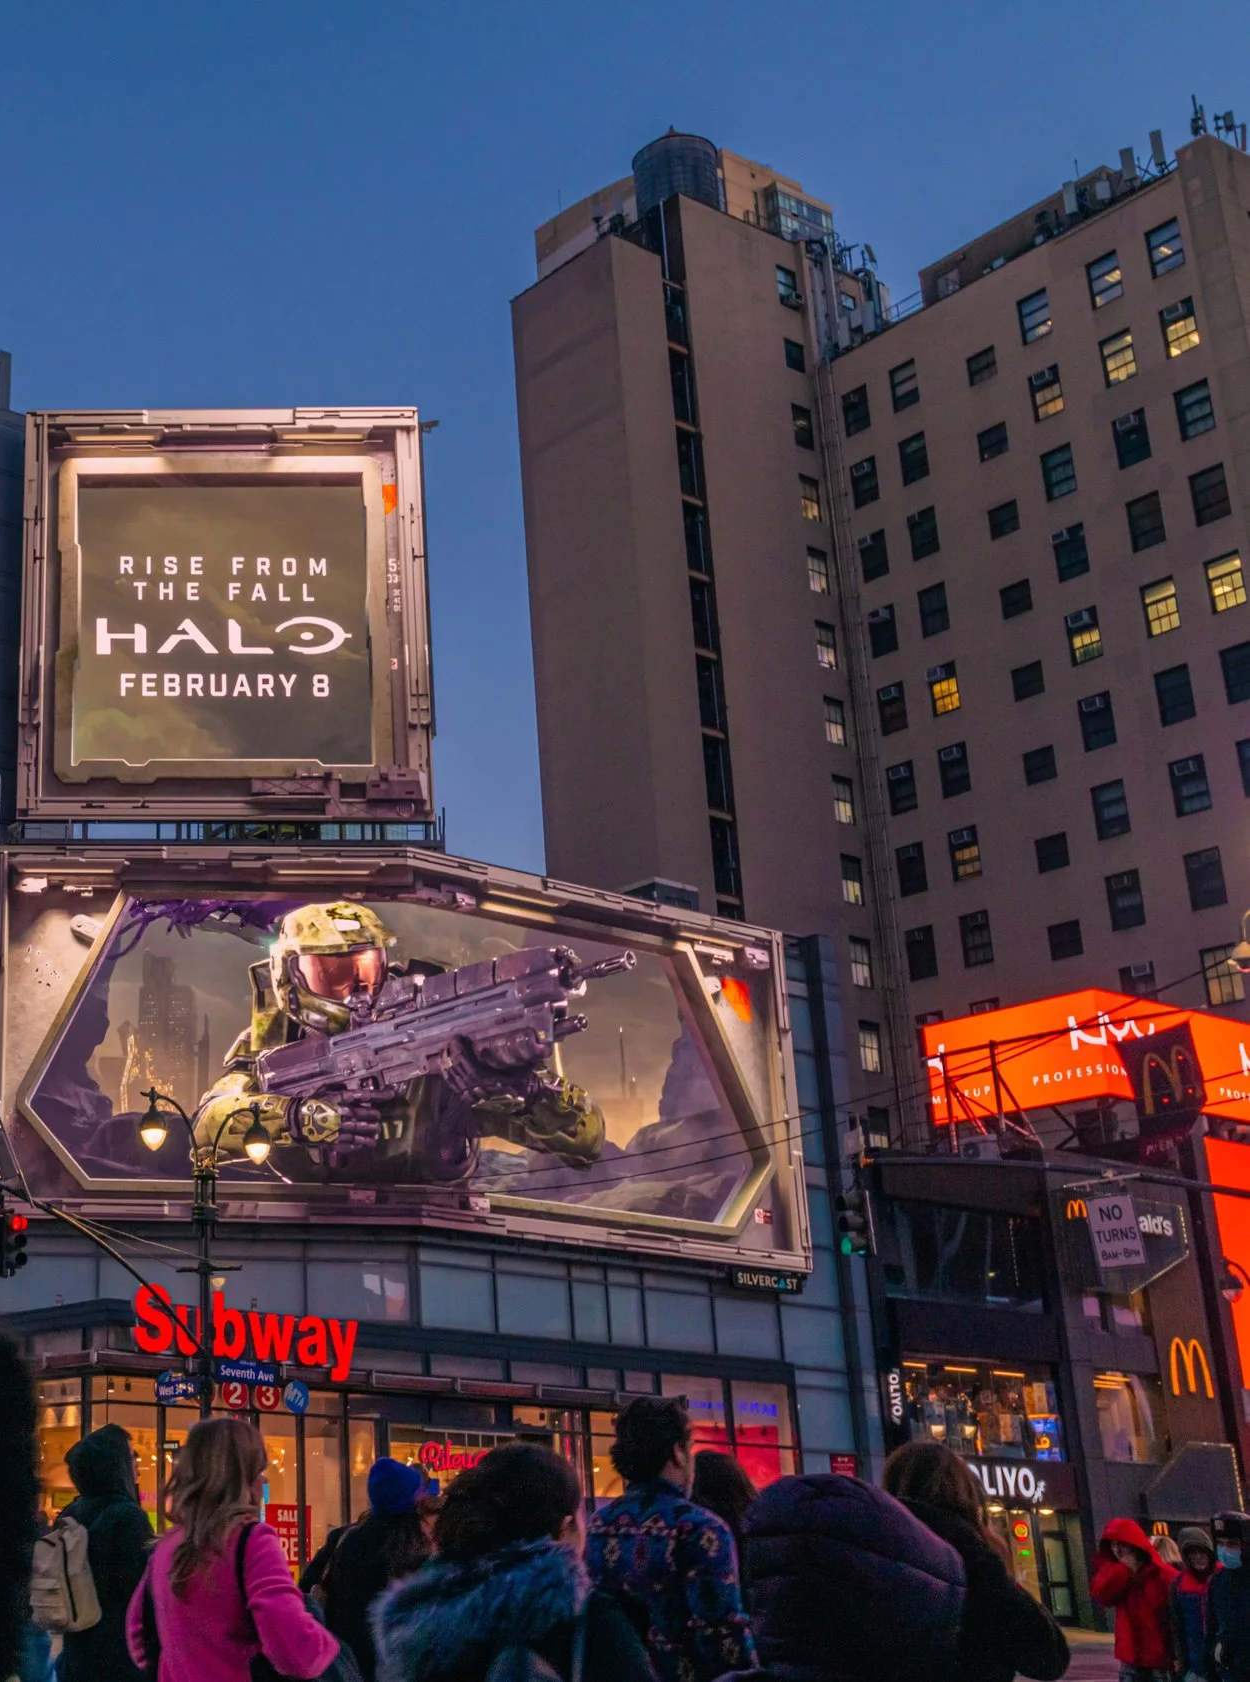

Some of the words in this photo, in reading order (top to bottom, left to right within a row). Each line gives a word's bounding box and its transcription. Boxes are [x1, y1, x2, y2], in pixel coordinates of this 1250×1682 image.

[120, 556, 203, 575] RISE
[232, 557, 327, 576] FROM
[134, 582, 200, 600] THE
[228, 583, 315, 601] FALL
[96, 616, 352, 655] HALO
[120, 673, 297, 697] FEBRUARY
[313, 674, 329, 697] 8
[932, 1085, 991, 1105] MEUP
[1099, 1204, 1123, 1222] NO
[1096, 1227, 1137, 1243] TURNS
[1101, 1248, 1141, 1261] 8AM-8PM
[737, 1271, 798, 1290] SILVERCAST
[134, 1283, 358, 1382] Subway
[220, 1364, 256, 1380] Seventh
[258, 1371, 275, 1383] Ave
[159, 1385, 174, 1396] West
[229, 1382, 242, 1405] 2
[261, 1385, 275, 1407] 3
[284, 1383, 306, 1408] MTA
